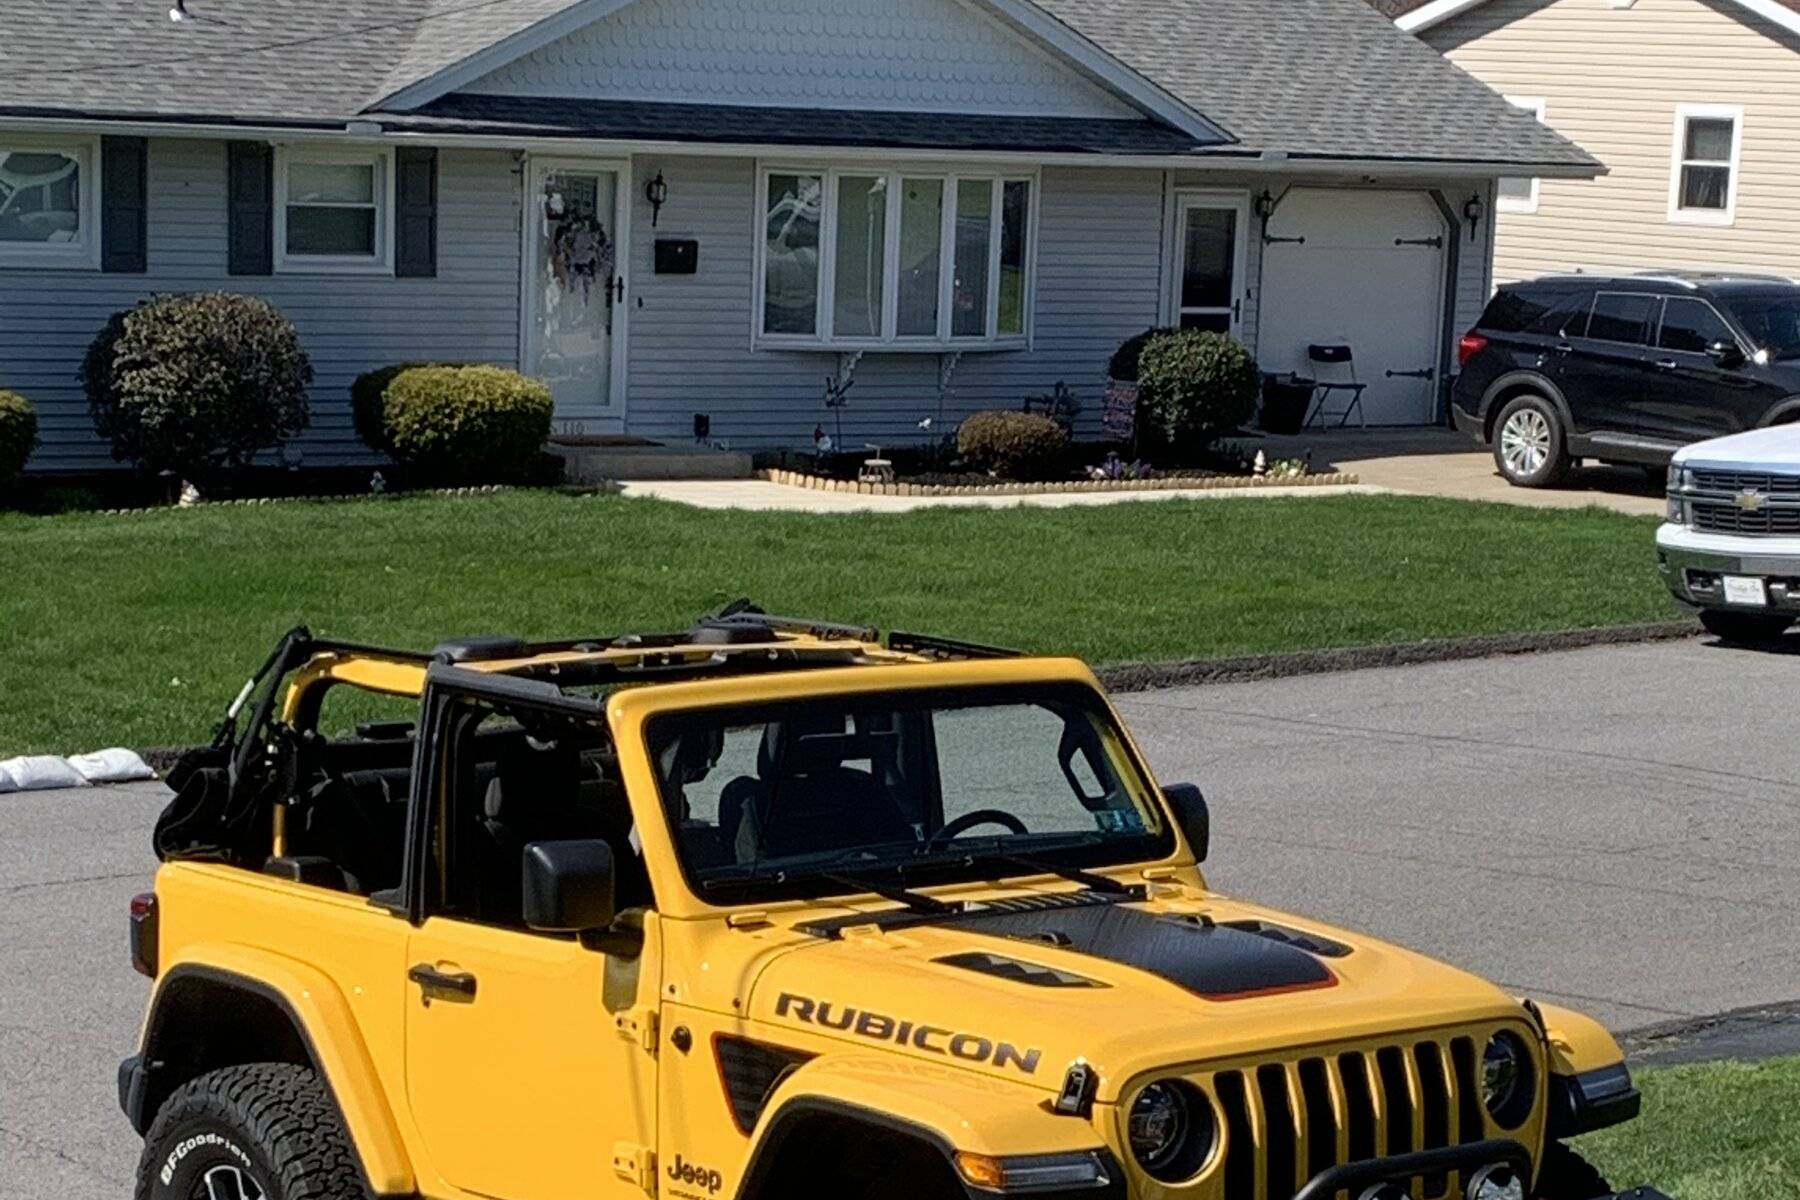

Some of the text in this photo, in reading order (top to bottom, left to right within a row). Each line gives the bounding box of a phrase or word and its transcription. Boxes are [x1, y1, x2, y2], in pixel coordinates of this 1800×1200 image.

[774, 991, 1042, 1074] RUBICON
[160, 1132, 252, 1186] BFGoodrich
[667, 1153, 722, 1196] Jeep
